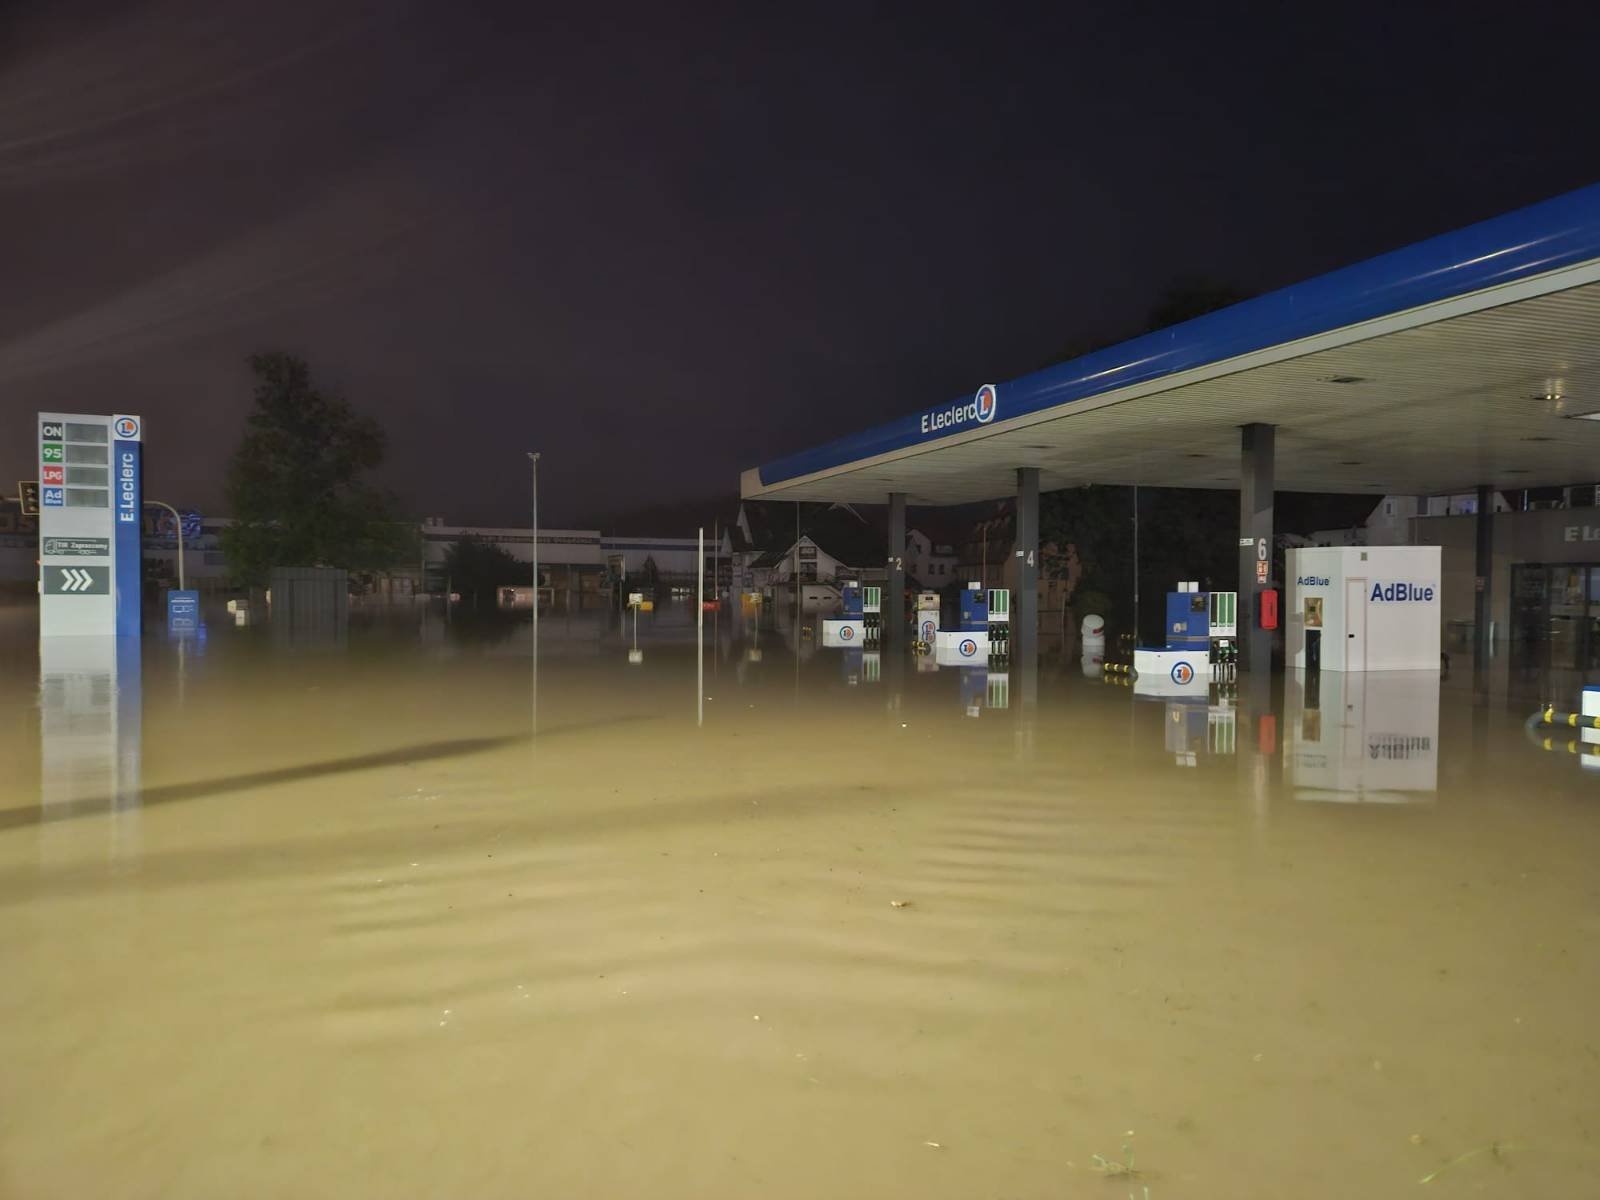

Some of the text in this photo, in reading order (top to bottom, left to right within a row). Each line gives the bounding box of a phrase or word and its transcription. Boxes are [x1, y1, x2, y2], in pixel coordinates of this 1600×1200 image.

[43, 426, 62, 436] ON
[44, 448, 62, 458] 95
[43, 471, 62, 480] LPG
[45, 490, 62, 498] Ad
[1258, 538, 1267, 560] 6
[896, 557, 902, 570] 2
[1026, 551, 1034, 567] 4
[1297, 576, 1330, 586] AdBlue
[1370, 583, 1434, 601] AdBlue
